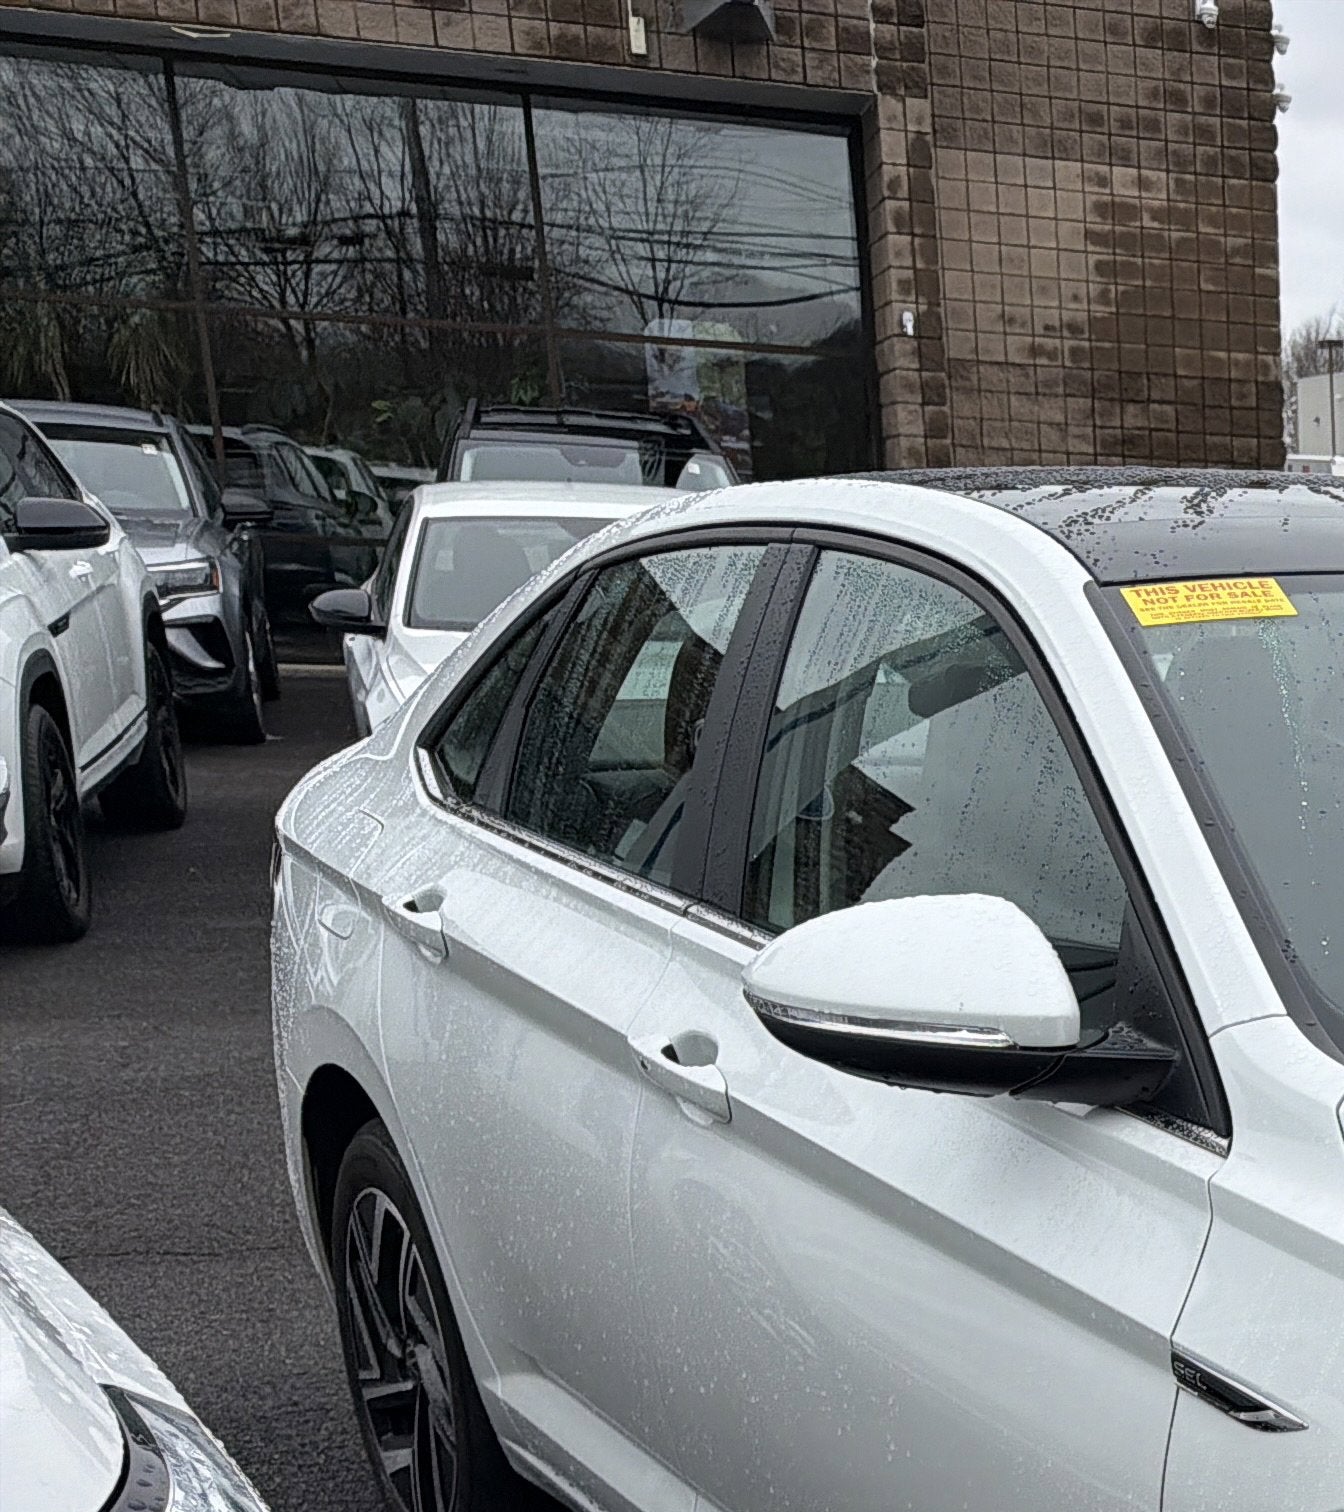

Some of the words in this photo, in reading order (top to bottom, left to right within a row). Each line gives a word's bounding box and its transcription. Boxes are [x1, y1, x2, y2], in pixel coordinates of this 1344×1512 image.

[1129, 585, 1181, 598] THIS
[1183, 580, 1273, 594] VEHICLE
[1141, 596, 1178, 606] NOT
[1186, 592, 1221, 603] FOR
[1228, 590, 1274, 599] SALE
[1173, 1361, 1207, 1391] SEL
